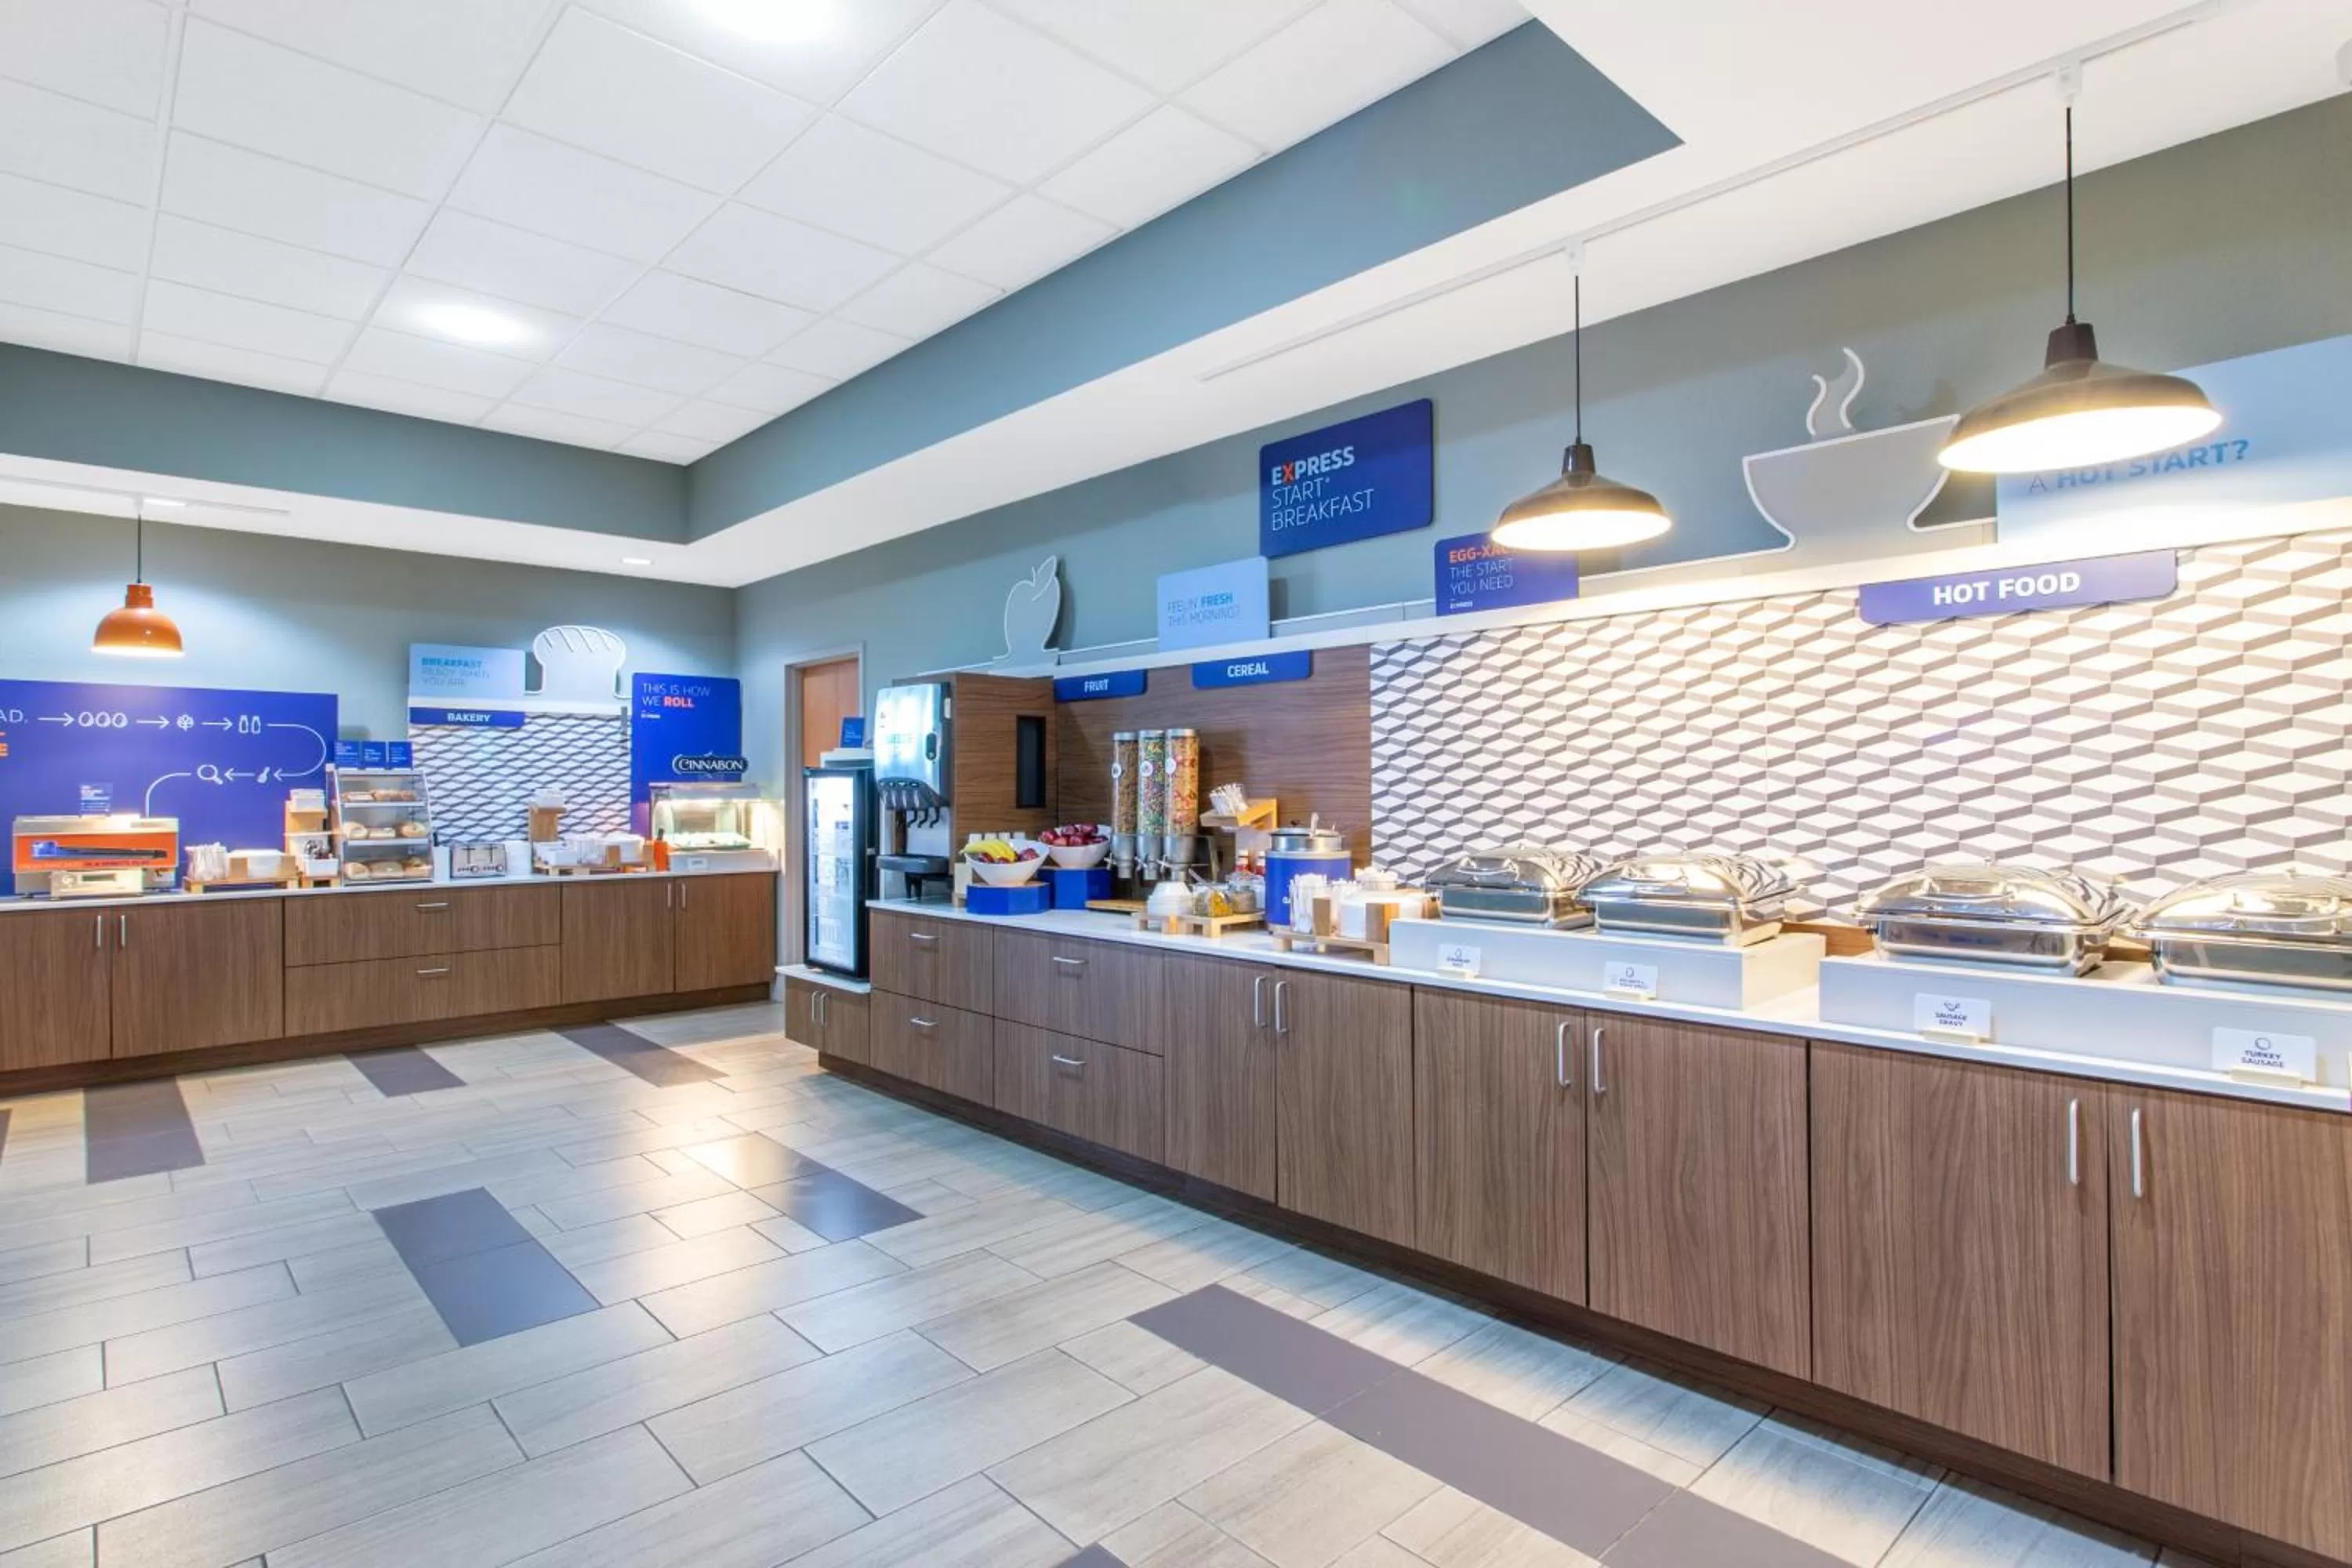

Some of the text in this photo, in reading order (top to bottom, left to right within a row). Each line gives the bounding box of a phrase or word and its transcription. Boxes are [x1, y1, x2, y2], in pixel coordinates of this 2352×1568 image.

[1272, 445, 1356, 486] EXPRESS
[2029, 439, 2249, 493] A HOT START?
[1272, 488, 1374, 532] BREAKFAST
[1449, 543, 1512, 563] EGG-XA
[1449, 558, 1514, 581] THE START
[1450, 575, 1514, 597] YOU NEED
[1933, 572, 2082, 605] HOT FOOD
[1200, 593, 1233, 607] FRESH
[1227, 662, 1269, 677] CEREAL
[642, 683, 711, 696] THIS IS HOW
[1084, 679, 1109, 692] FRUIT
[642, 695, 695, 708] WE ROLL
[447, 713, 492, 723] BAKERY
[678, 758, 743, 771] CINNABON
[2241, 1056, 2285, 1068] SAUSAGE
[2245, 1050, 2282, 1060] TURKEY
